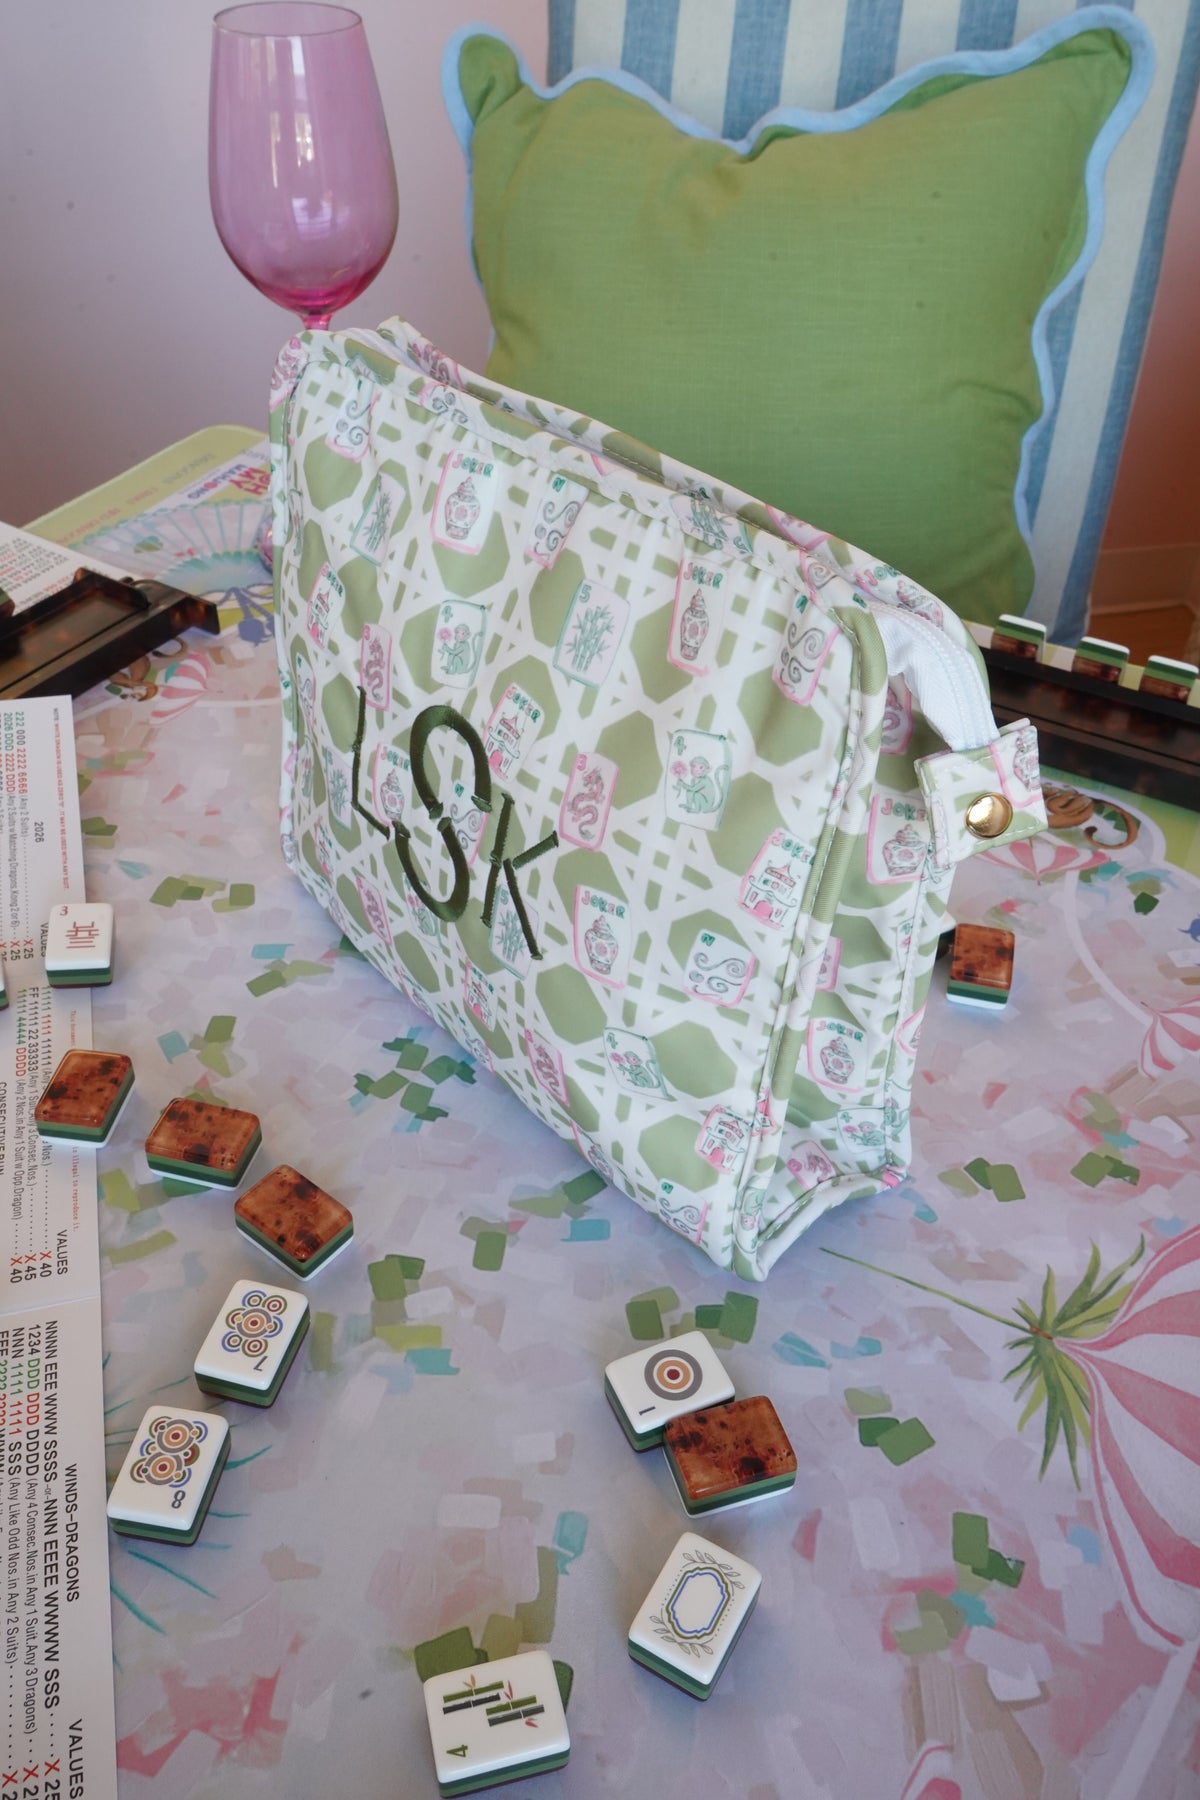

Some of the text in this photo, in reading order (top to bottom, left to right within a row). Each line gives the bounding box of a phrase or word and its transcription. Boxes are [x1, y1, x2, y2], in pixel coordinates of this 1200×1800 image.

[579, 585, 592, 603] 5
[4, 713, 13, 731] 2026
[15, 712, 24, 727] 222
[4, 733, 14, 750] DDD
[16, 730, 26, 746] 000
[5, 753, 15, 772] 2222
[17, 748, 27, 769] 2222
[577, 754, 587, 770] 3
[6, 774, 16, 792] DDD
[18, 772, 28, 794] 6666
[881, 798, 927, 821] JOKE
[34, 822, 44, 842] 2026
[60, 906, 68, 916] 3
[582, 891, 626, 919] JOKER
[10, 940, 20, 948] X
[24, 948, 34, 959] 25
[10, 950, 20, 961] 25
[17, 989, 26, 1014] 11111
[29, 987, 38, 998] FF
[29, 1001, 38, 1026] 11111
[16, 1017, 26, 1045] 44444
[28, 1030, 38, 1040] 22
[41, 1014, 51, 1035] 1111
[816, 1021, 864, 1042] JOKER
[16, 1047, 26, 1077] DDDD
[28, 1042, 38, 1072] 33333
[41, 1038, 51, 1066] 11111
[14, 1126, 25, 1139] Any
[14, 1146, 25, 1160] Suit
[72, 1189, 80, 1220] reproduce
[10, 1256, 22, 1266] X
[25, 1254, 36, 1263] X
[40, 1251, 52, 1260] X
[57, 1229, 68, 1275] VALUES
[10, 1268, 22, 1283] 40
[25, 1266, 36, 1280] 45
[40, 1263, 52, 1277] 40
[12, 1327, 24, 1359] NNN
[28, 1324, 40, 1355] 1234
[45, 1320, 57, 1359] NNNN
[10, 1363, 24, 1395] 1111
[27, 1358, 40, 1389] DDD
[44, 1362, 57, 1391] EEE
[10, 1401, 22, 1435] 1111
[27, 1392, 40, 1426] DDD
[44, 1393, 57, 1435] WWW
[8, 1441, 21, 1476] SSS
[26, 1430, 39, 1476] DDDD
[44, 1440, 57, 1482] SSSS
[7, 1477, 21, 1500] (Any
[25, 1479, 39, 1500] (Any
[171, 1490, 186, 1509] 8
[8, 1504, 21, 1525] Like
[44, 1499, 58, 1536] NNN
[8, 1528, 20, 1550] Odd
[44, 1540, 58, 1588] EEEE
[5, 1593, 19, 1613] Any
[24, 1587, 38, 1606] Any
[44, 1590, 59, 1662] WWWW
[5, 1627, 19, 1664] Suits)
[26, 1667, 38, 1676] 3
[44, 1668, 60, 1709] SSS
[24, 1678, 38, 1734] Dragons)
[69, 1719, 83, 1800] VALUES
[446, 1744, 468, 1758] 4
[23, 1764, 39, 1782] X
[44, 1759, 60, 1776] X
[2, 1770, 18, 1788] X
[23, 1785, 39, 1800] 2
[45, 1780, 60, 1800] 25
